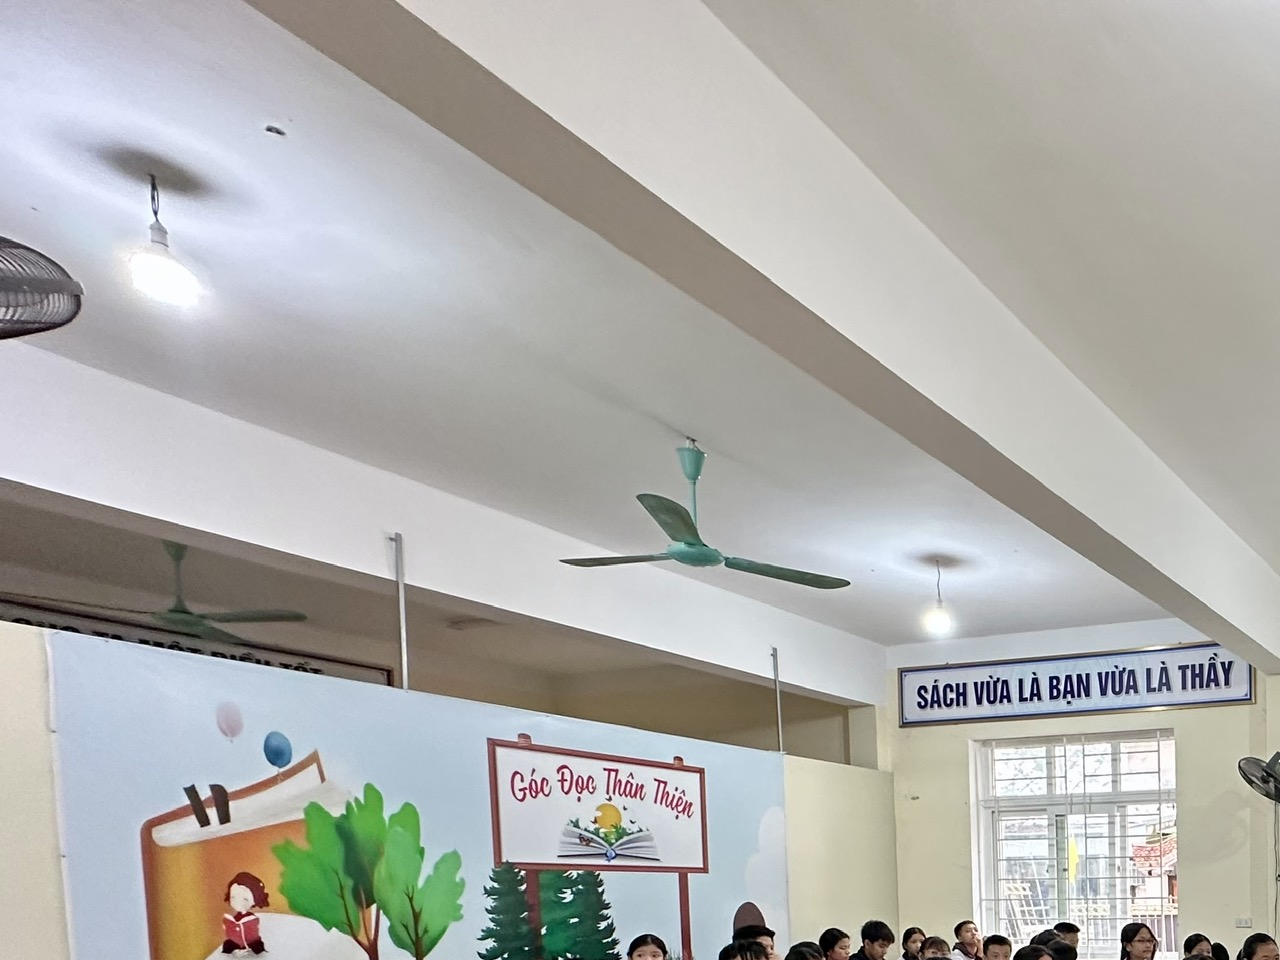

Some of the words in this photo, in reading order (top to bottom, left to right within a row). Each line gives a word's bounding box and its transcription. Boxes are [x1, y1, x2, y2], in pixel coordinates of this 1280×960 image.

[916, 681, 968, 710] SÁCH
[973, 675, 1012, 707] VỪA
[1018, 672, 1042, 703] LÀ
[1050, 672, 1091, 705] BẠN
[1097, 666, 1139, 697] VỪA
[1146, 661, 1172, 693] LÀ
[1179, 653, 1234, 690] THẦY
[510, 768, 552, 802] Góc
[556, 764, 597, 803] Đọc
[602, 767, 647, 801] Thân
[653, 777, 695, 820] Thiện
